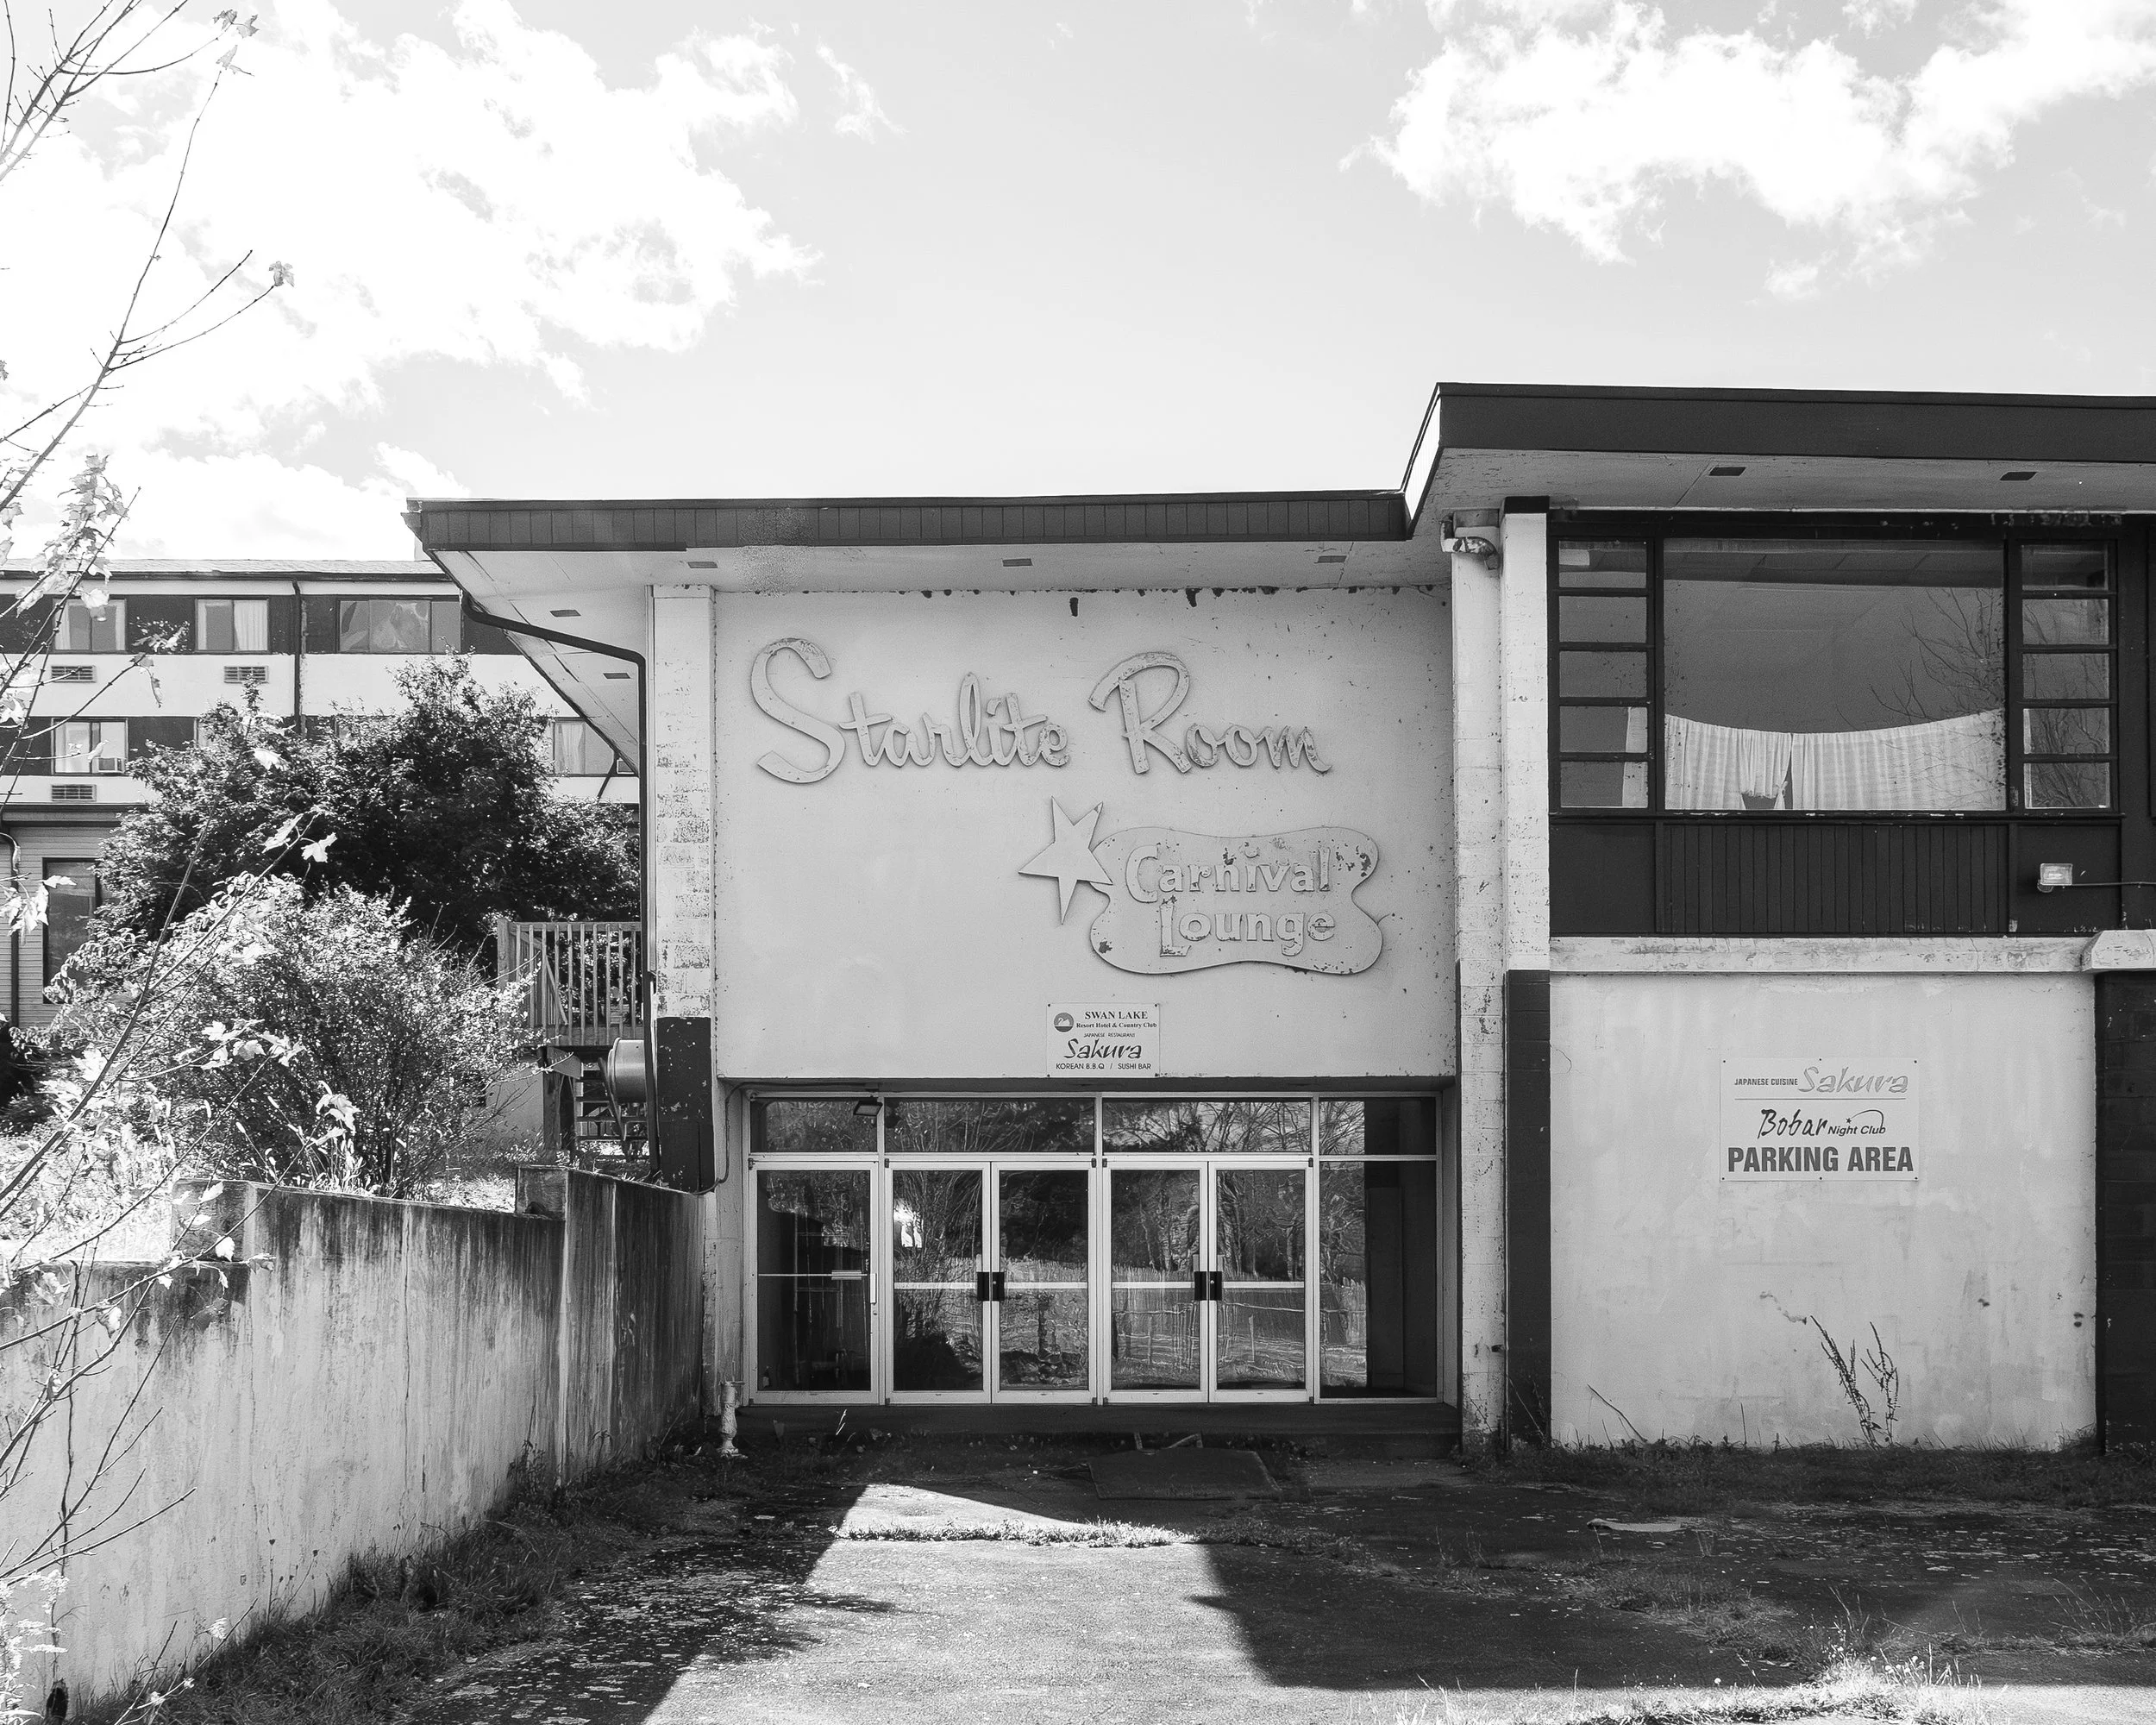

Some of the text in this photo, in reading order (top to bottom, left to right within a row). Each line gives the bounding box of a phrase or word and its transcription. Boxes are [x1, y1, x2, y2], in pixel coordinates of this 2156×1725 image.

[750, 637, 1332, 784] Starlite Room
[1125, 844, 1331, 903] Carnival
[1159, 903, 1336, 957] Lounge
[1085, 1011, 1148, 1019] SWAN LAKE
[1063, 1038, 1142, 1059] Sakura
[1797, 1066, 1908, 1094] Sakura
[1758, 1109, 1886, 1139] Bobar Night Club
[1727, 1146, 1914, 1172] PARKING AREA
